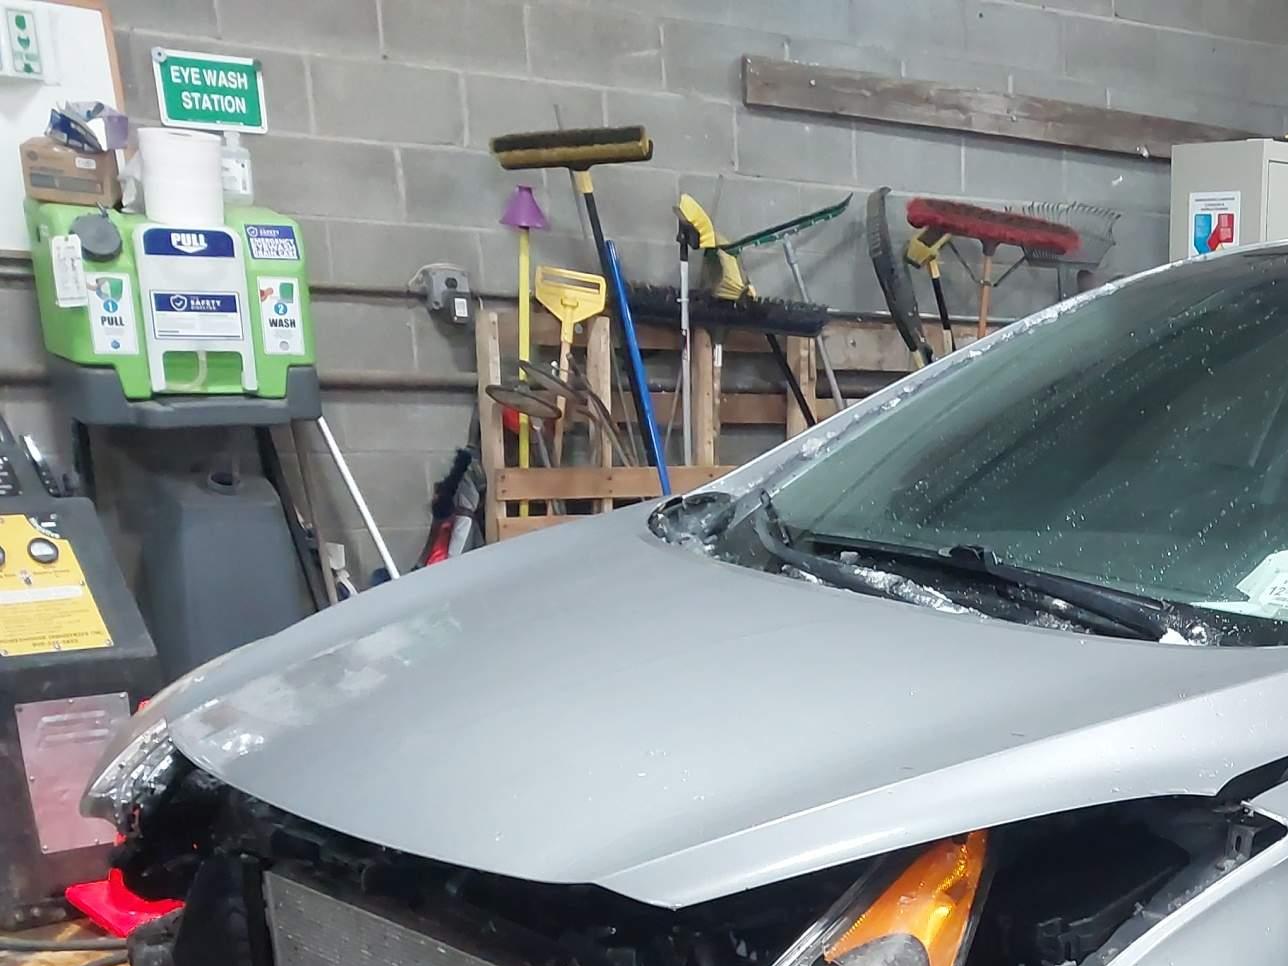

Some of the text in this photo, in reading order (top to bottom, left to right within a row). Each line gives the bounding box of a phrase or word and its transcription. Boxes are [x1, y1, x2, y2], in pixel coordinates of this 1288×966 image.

[170, 65, 248, 90] EYE WASH
[181, 91, 247, 114] STATION
[171, 232, 208, 248] PULL
[277, 303, 284, 314] 2
[101, 316, 125, 326] PULL
[269, 318, 296, 328] WASH
[1269, 585, 1287, 596] 12
